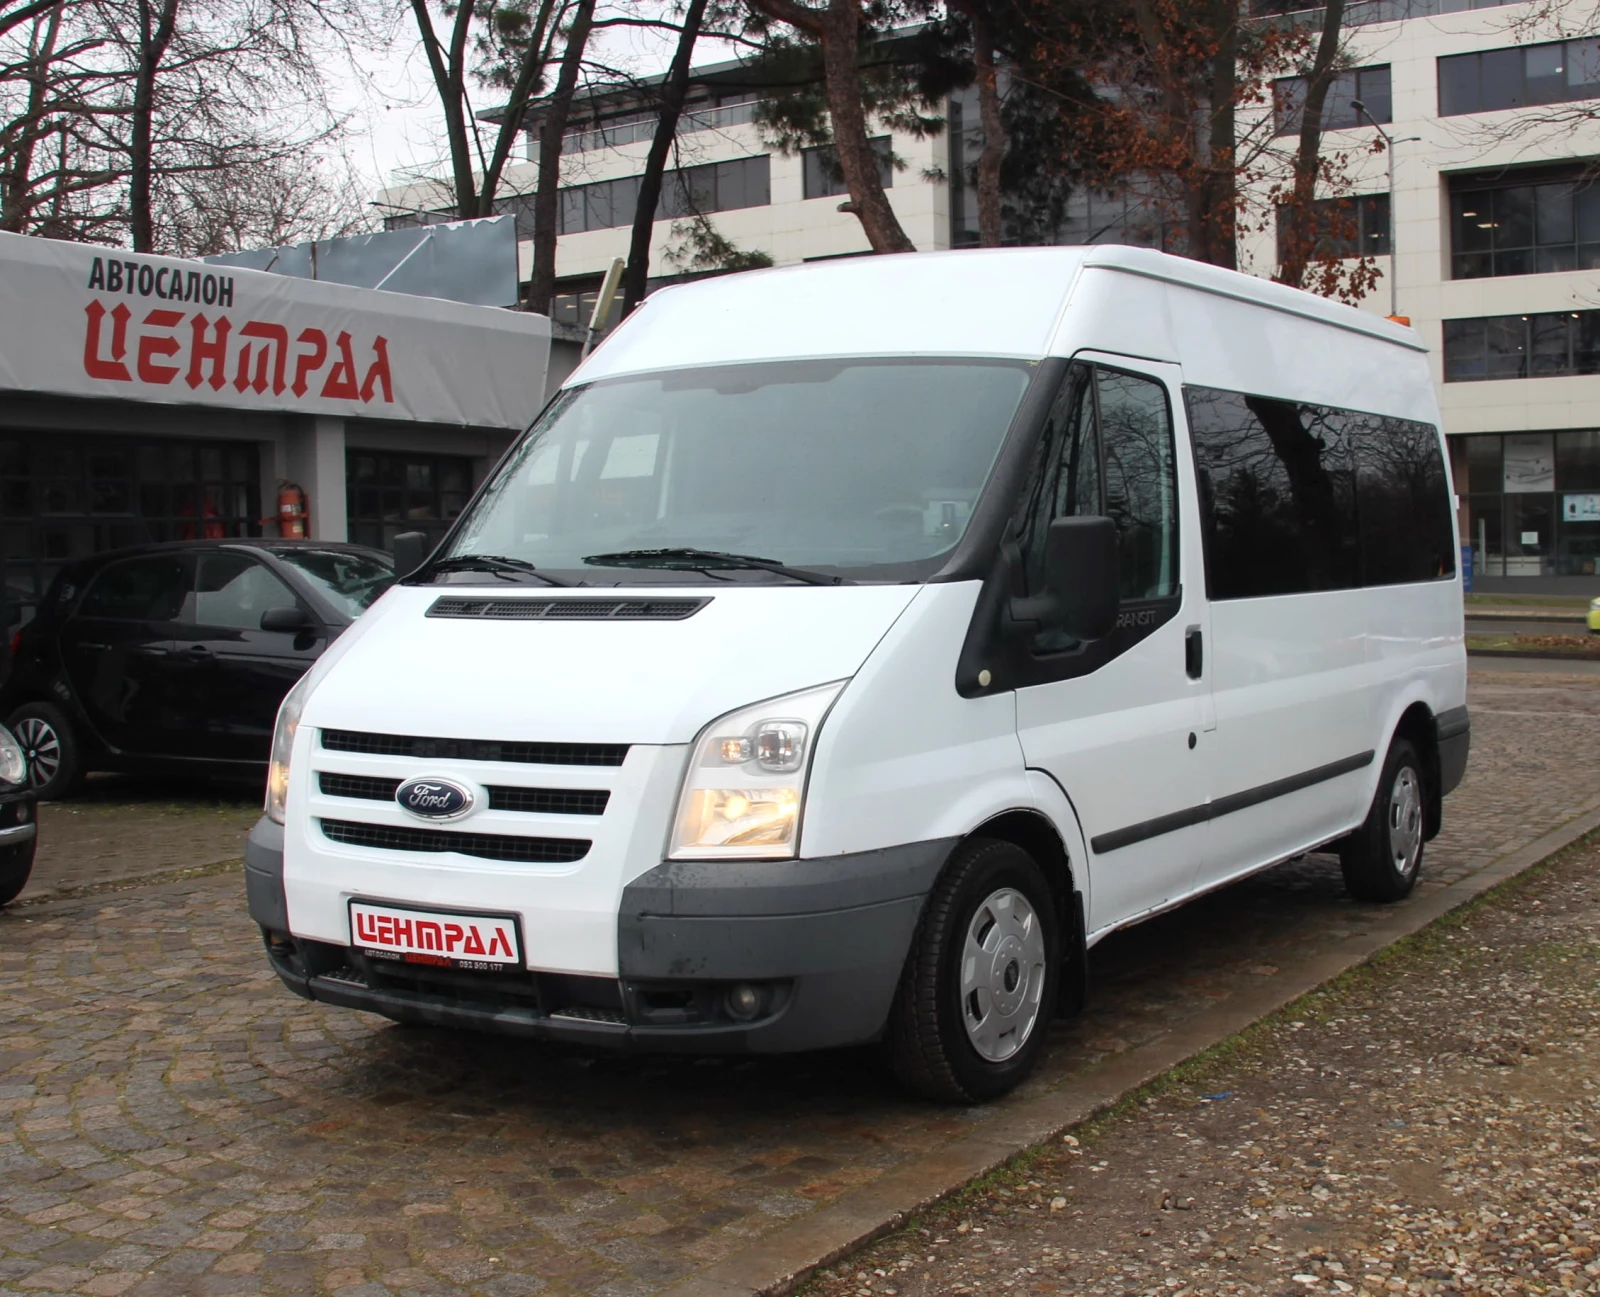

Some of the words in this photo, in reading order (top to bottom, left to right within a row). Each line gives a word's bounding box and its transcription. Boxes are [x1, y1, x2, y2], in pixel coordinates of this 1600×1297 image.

[87, 256, 234, 308] АВТОСАЛОН
[83, 298, 394, 404] ЦЕНТРАЛ
[1116, 610, 1156, 628] RANSIT
[409, 783, 451, 808] Ford
[356, 912, 514, 957] ЦЕНТРАЛ
